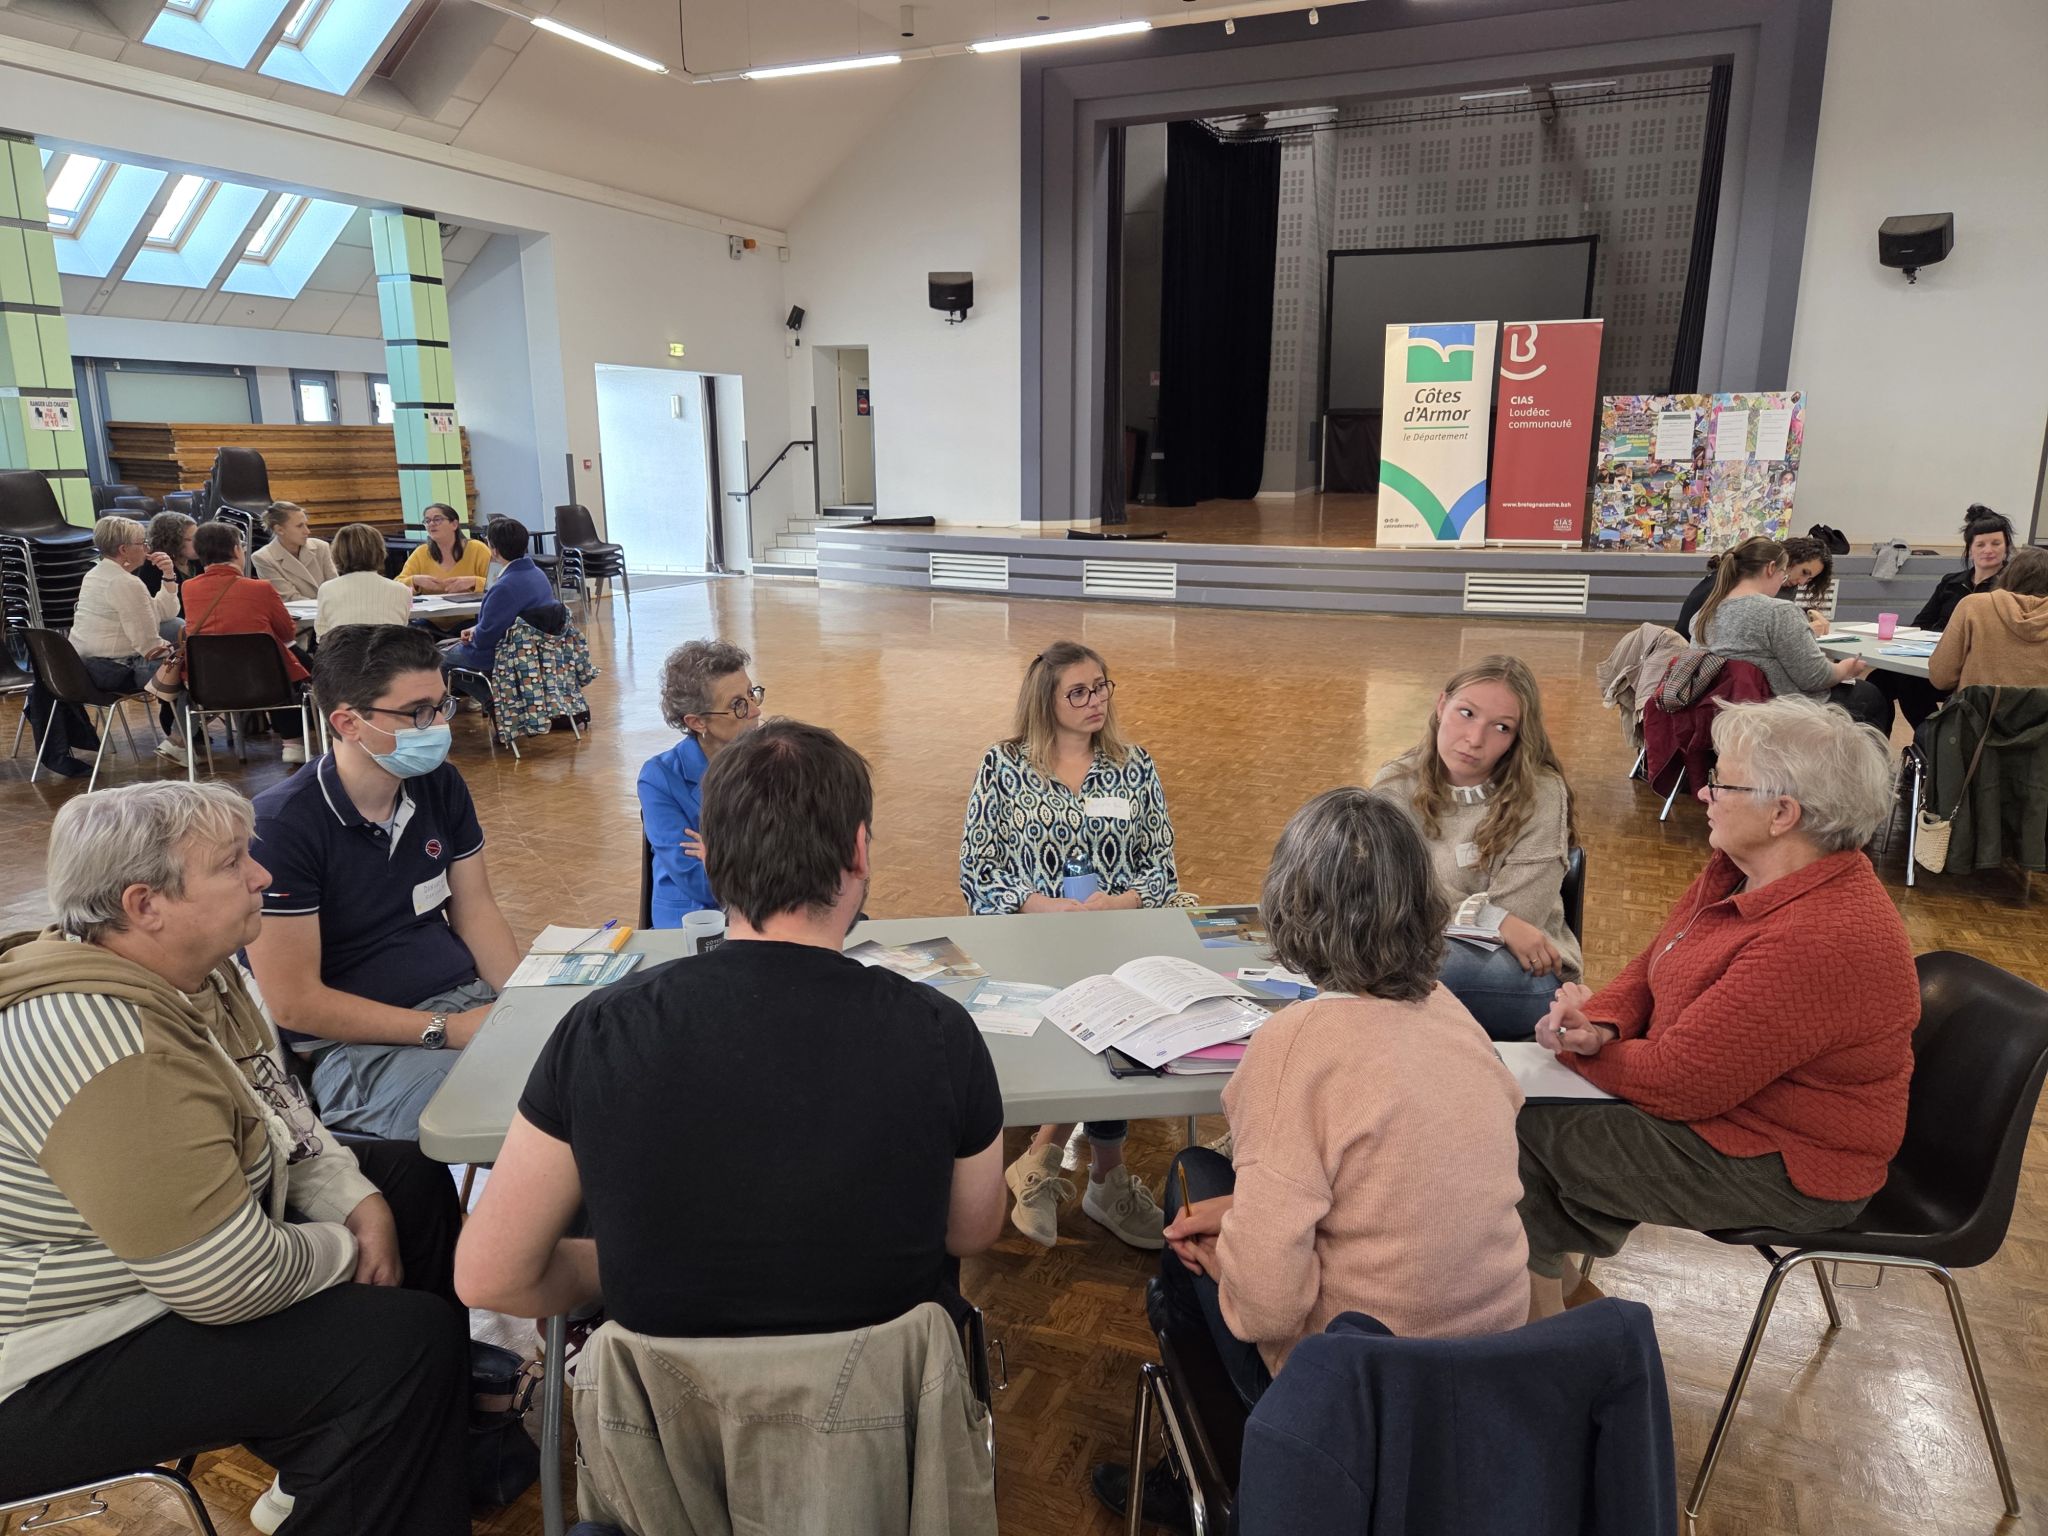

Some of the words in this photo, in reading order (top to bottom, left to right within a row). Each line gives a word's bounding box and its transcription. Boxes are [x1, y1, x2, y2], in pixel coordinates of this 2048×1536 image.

[1415, 388, 1462, 403] Côtes
[1510, 396, 1534, 405] CIAS
[1404, 407, 1471, 422] d'Armor
[1509, 408, 1550, 417] Loudéac
[1508, 419, 1572, 429] communauté
[1403, 433, 1411, 441] le
[1413, 433, 1468, 442] Département
